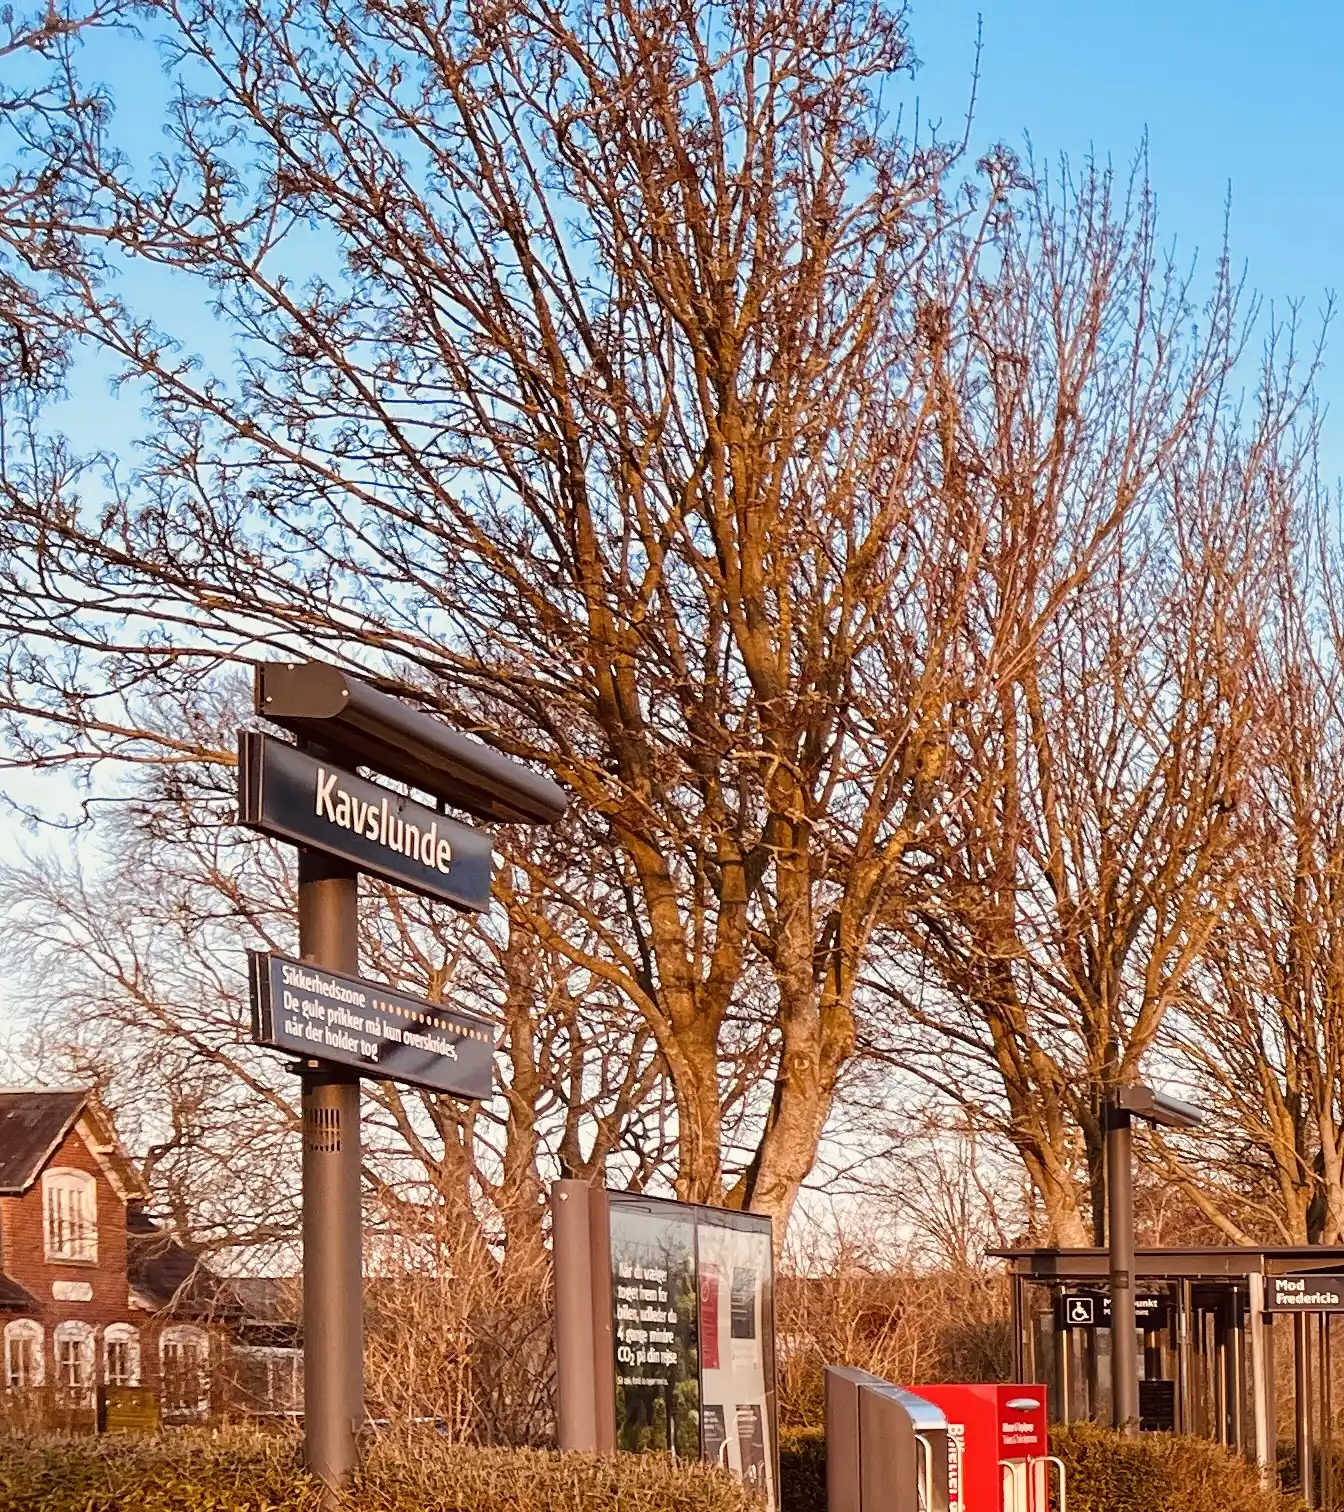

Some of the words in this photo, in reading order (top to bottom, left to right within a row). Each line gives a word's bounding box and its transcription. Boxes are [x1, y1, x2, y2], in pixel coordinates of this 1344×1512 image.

[316, 768, 451, 874] Kavslunde
[282, 965, 366, 1008] Sikkerhedszone
[283, 990, 299, 1012] De
[301, 999, 325, 1021] gule
[327, 1007, 364, 1032] prikker
[365, 1016, 380, 1036] må
[383, 1020, 401, 1042] kun
[403, 1030, 458, 1062] overskrides,
[284, 1018, 303, 1038] når
[305, 1024, 323, 1045] der
[325, 1026, 359, 1053] holder
[361, 1039, 379, 1063] tog
[1275, 1279, 1305, 1291] Mod
[1276, 1291, 1339, 1304] Fredericia
